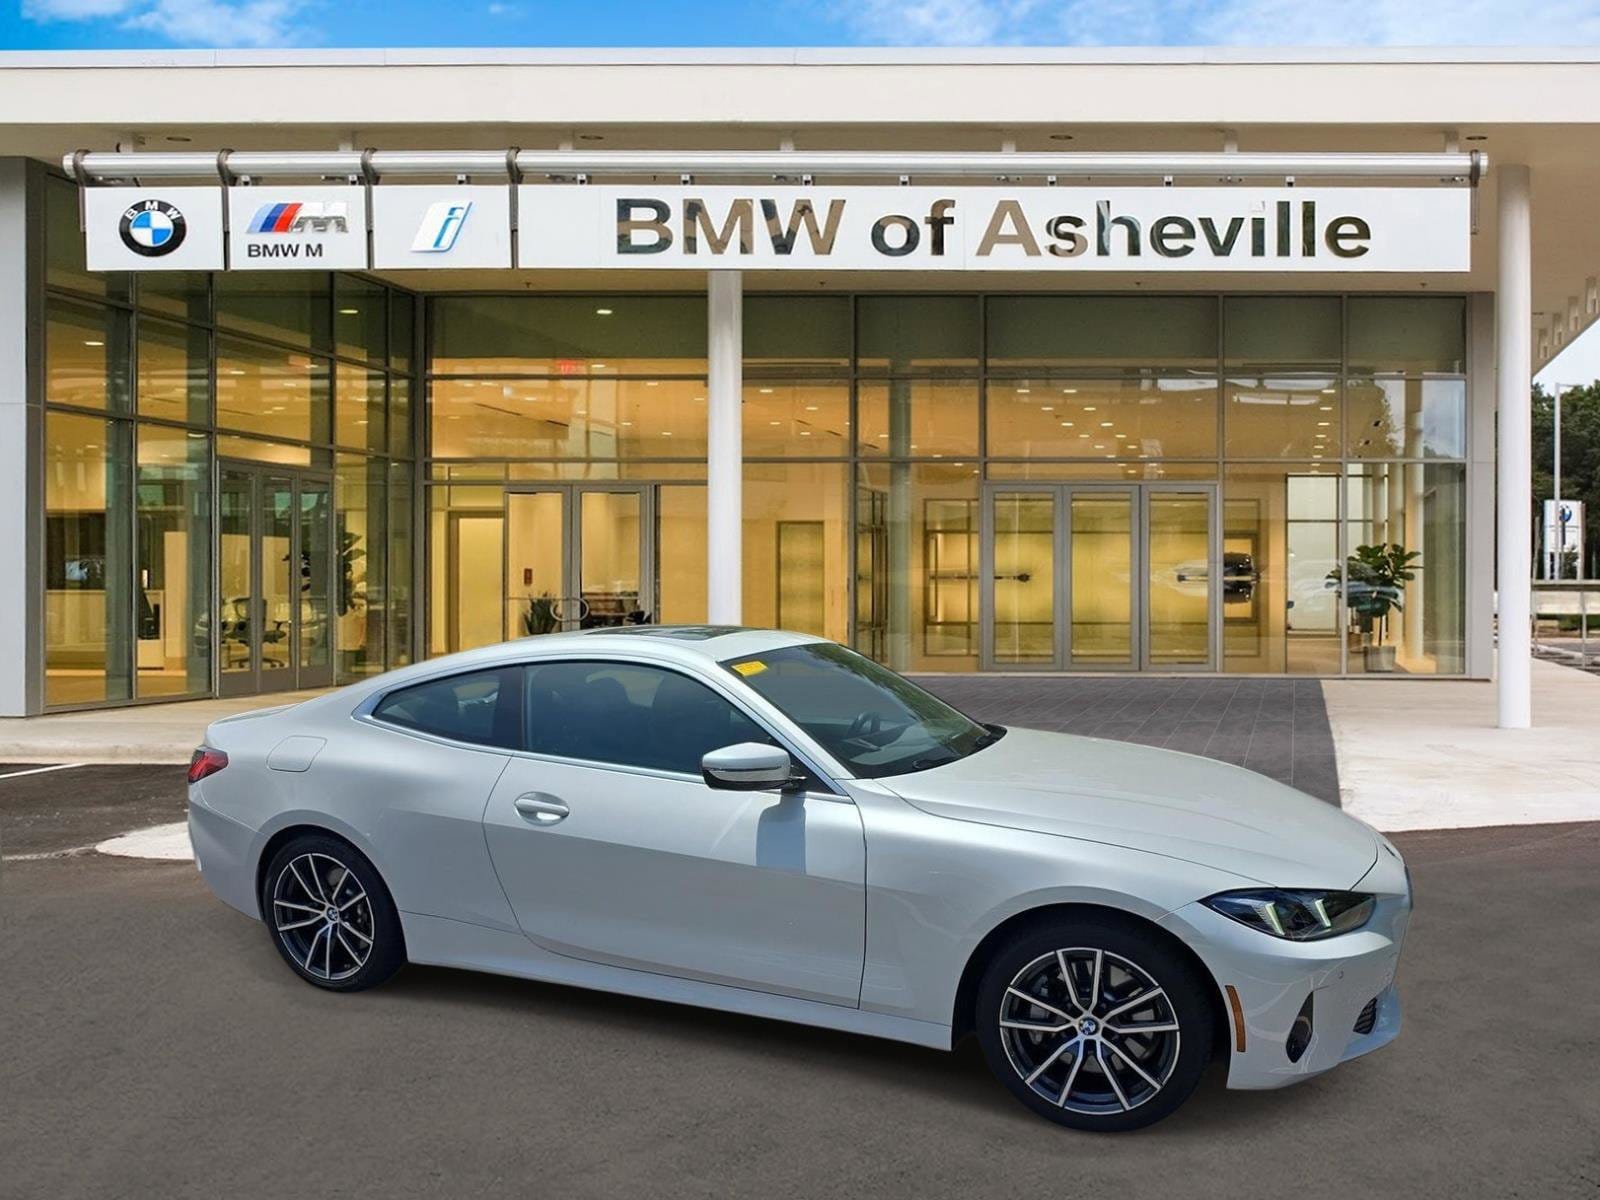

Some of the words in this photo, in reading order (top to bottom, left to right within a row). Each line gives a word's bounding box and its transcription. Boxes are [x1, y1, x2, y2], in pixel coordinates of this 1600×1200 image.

[124, 200, 182, 222] BMW
[617, 198, 846, 256] BMW
[871, 199, 956, 257] of
[975, 200, 1372, 258] Asheville
[247, 244, 300, 258] BMW
[306, 244, 323, 258] M
